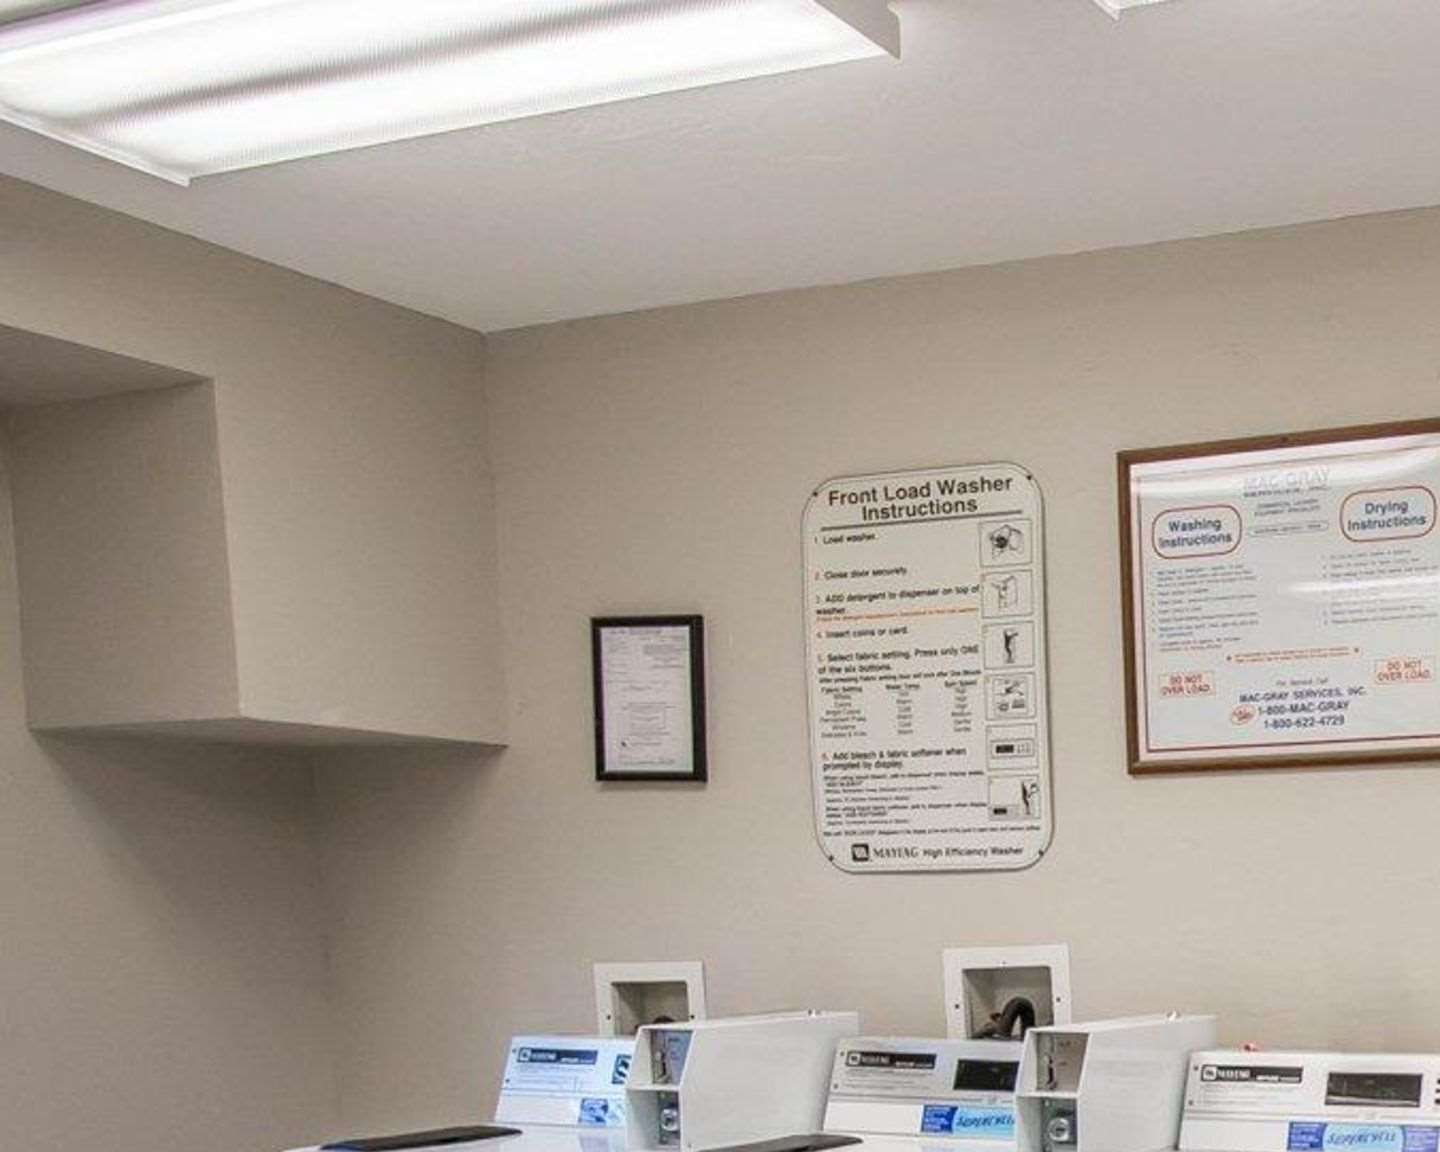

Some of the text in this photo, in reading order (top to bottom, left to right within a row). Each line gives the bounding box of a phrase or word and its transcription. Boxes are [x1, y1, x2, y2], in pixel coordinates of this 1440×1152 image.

[828, 476, 1014, 507] Front Load Washer
[862, 498, 978, 521] Instructions
[1365, 500, 1409, 518] Drying
[1168, 517, 1222, 535] Washing
[1347, 513, 1427, 532] Instructions
[1158, 532, 1233, 549] Instructions
[1239, 691, 1290, 703] MAC-GRAY
[1257, 700, 1350, 716] 1-800-MAC-GRAY
[873, 846, 920, 859] MAYTAG
[944, 846, 988, 859] Efficiency
[989, 845, 1024, 857] Washer
